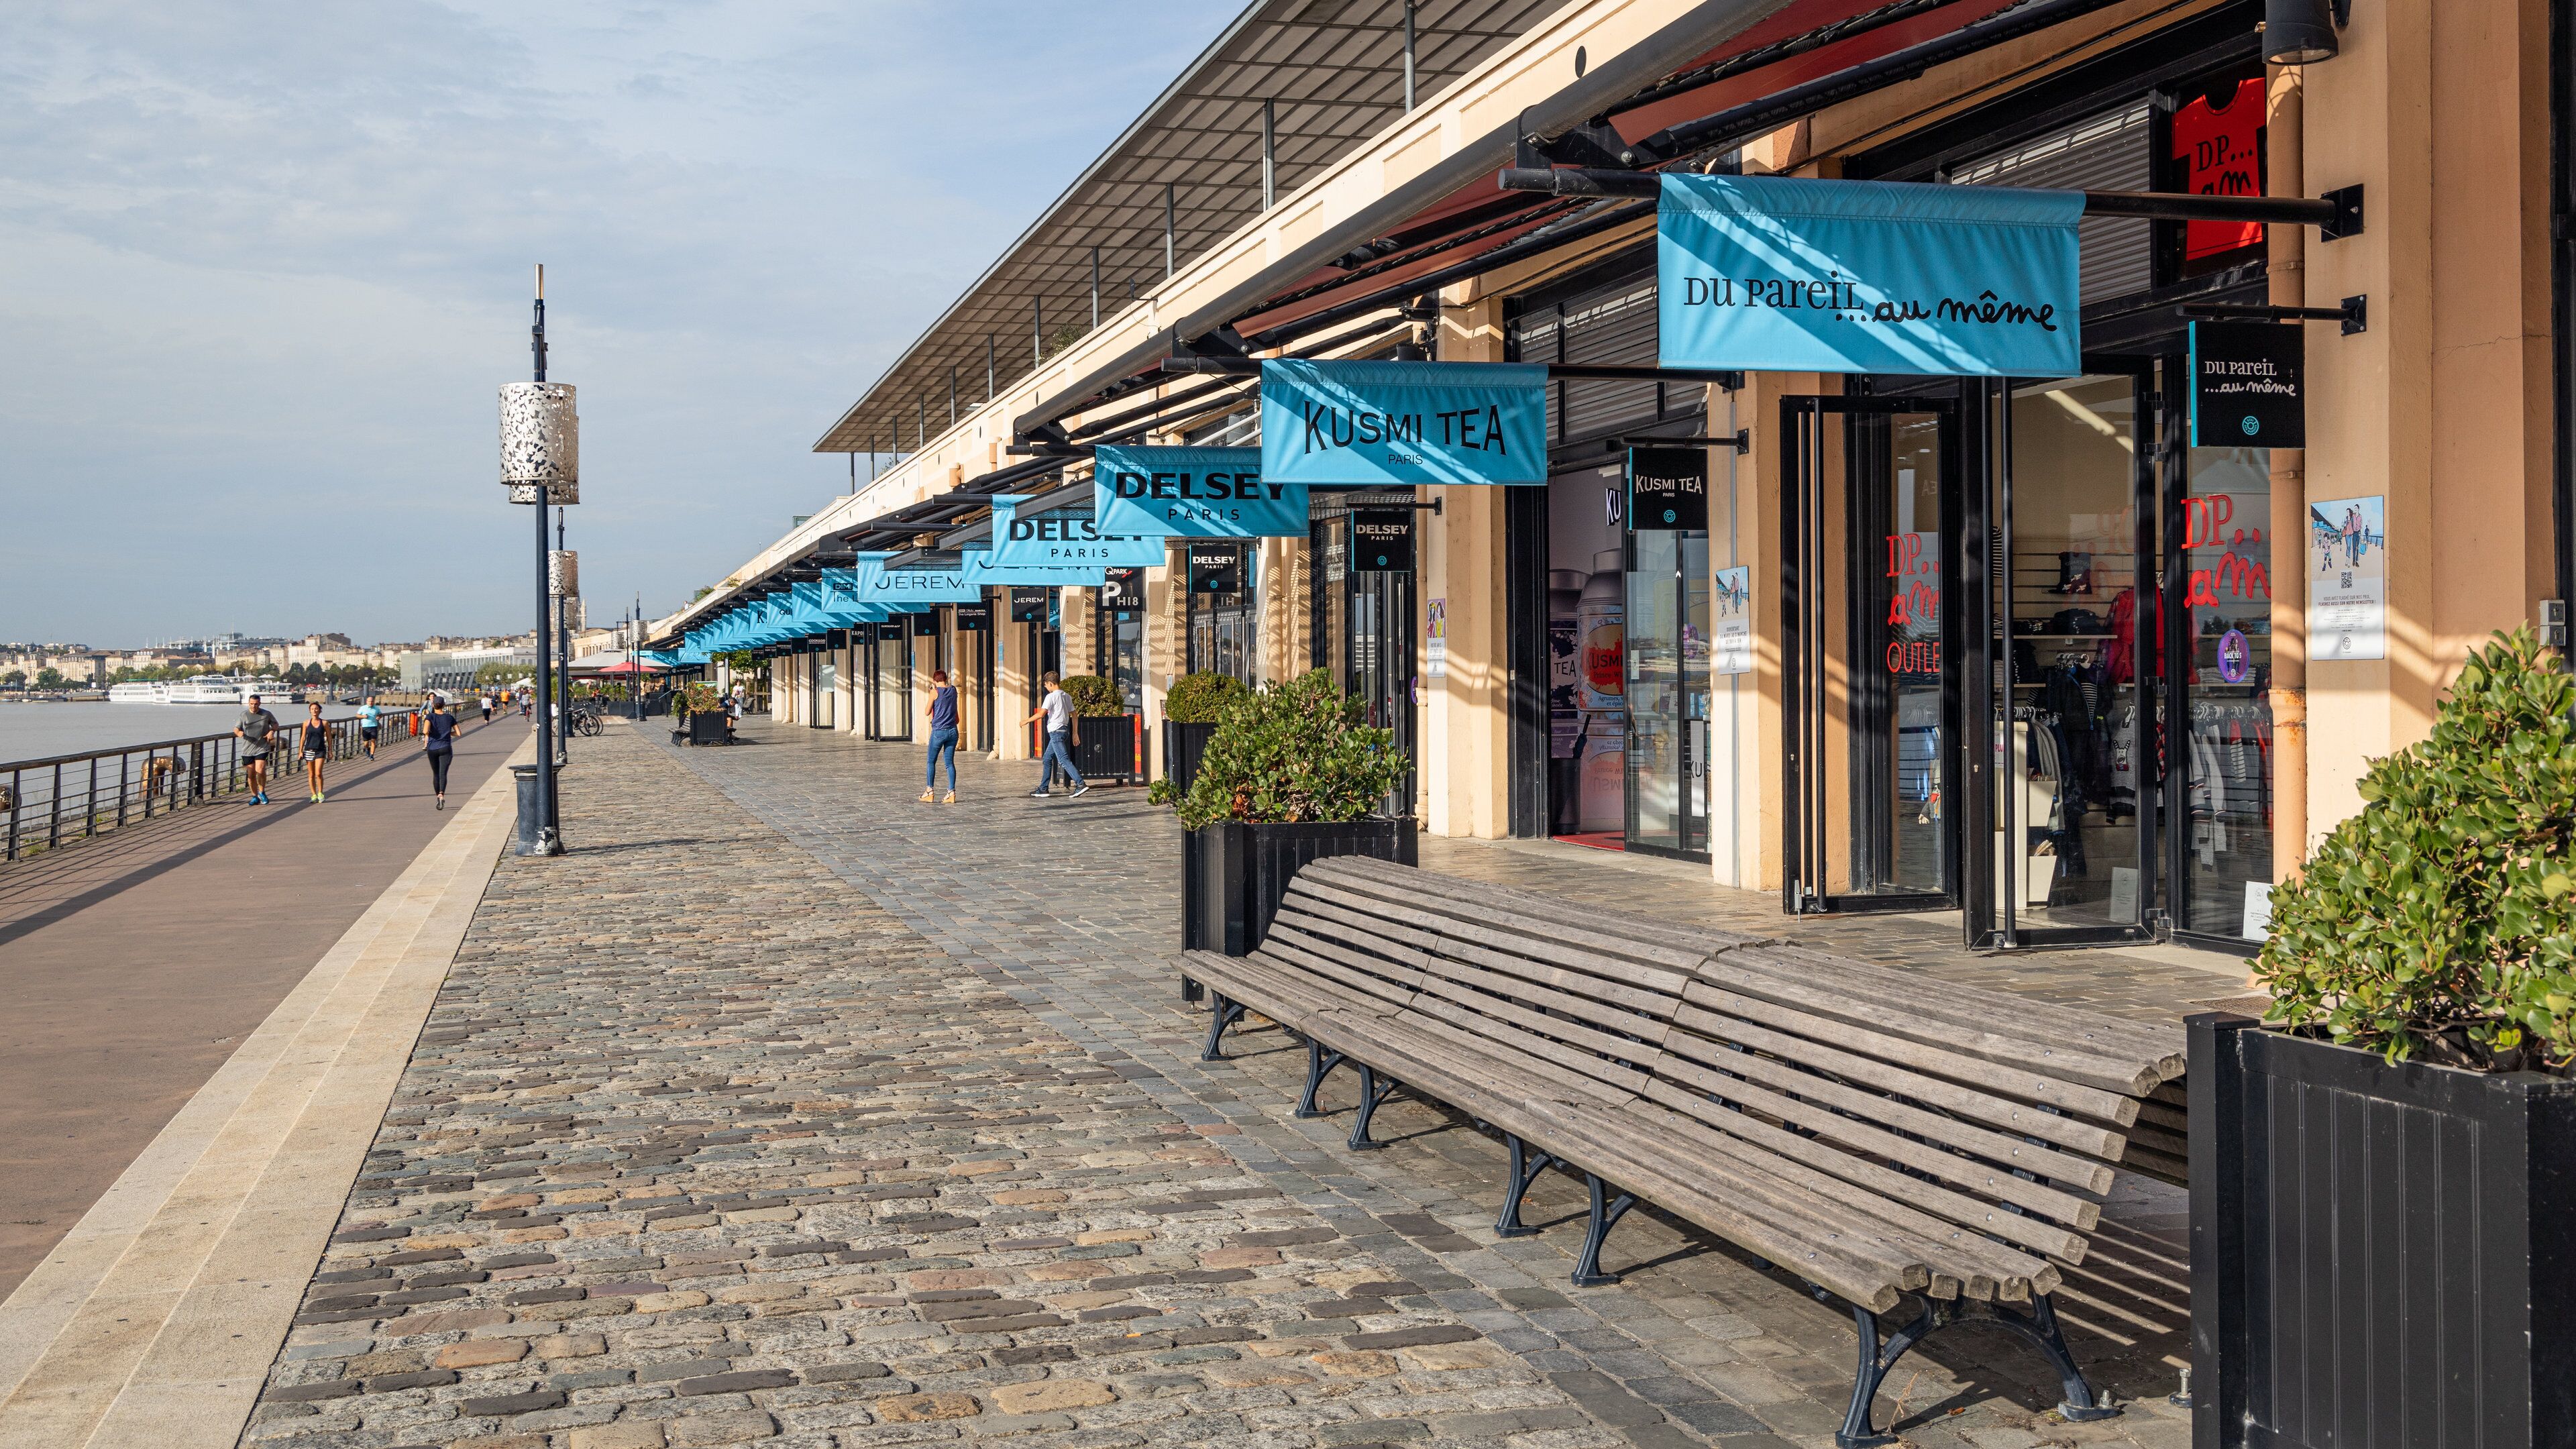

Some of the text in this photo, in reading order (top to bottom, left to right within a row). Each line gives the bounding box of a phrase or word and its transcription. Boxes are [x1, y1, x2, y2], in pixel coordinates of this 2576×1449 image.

[1937, 290, 2057, 331] même
[2246, 378, 2296, 396] même
[1304, 400, 1507, 456] KUSMI TEA
[1389, 454, 1423, 464] PARIS
[1116, 472, 1285, 500] DELSEY
[1635, 474, 1703, 494] KUSMI TEA
[1168, 508, 1240, 520] PARIS
[1605, 488, 1621, 527] KU
[1010, 520, 1142, 541] DELS
[1356, 525, 1409, 534] DELSEY
[1051, 548, 1109, 557] PARIS
[1192, 556, 1236, 564] DELSEY
[875, 576, 965, 590] JEREM
[2184, 551, 2271, 608] am
[833, 592, 849, 602] The
[1887, 642, 1940, 673] OUTLE
[1554, 660, 1576, 677] TEA
